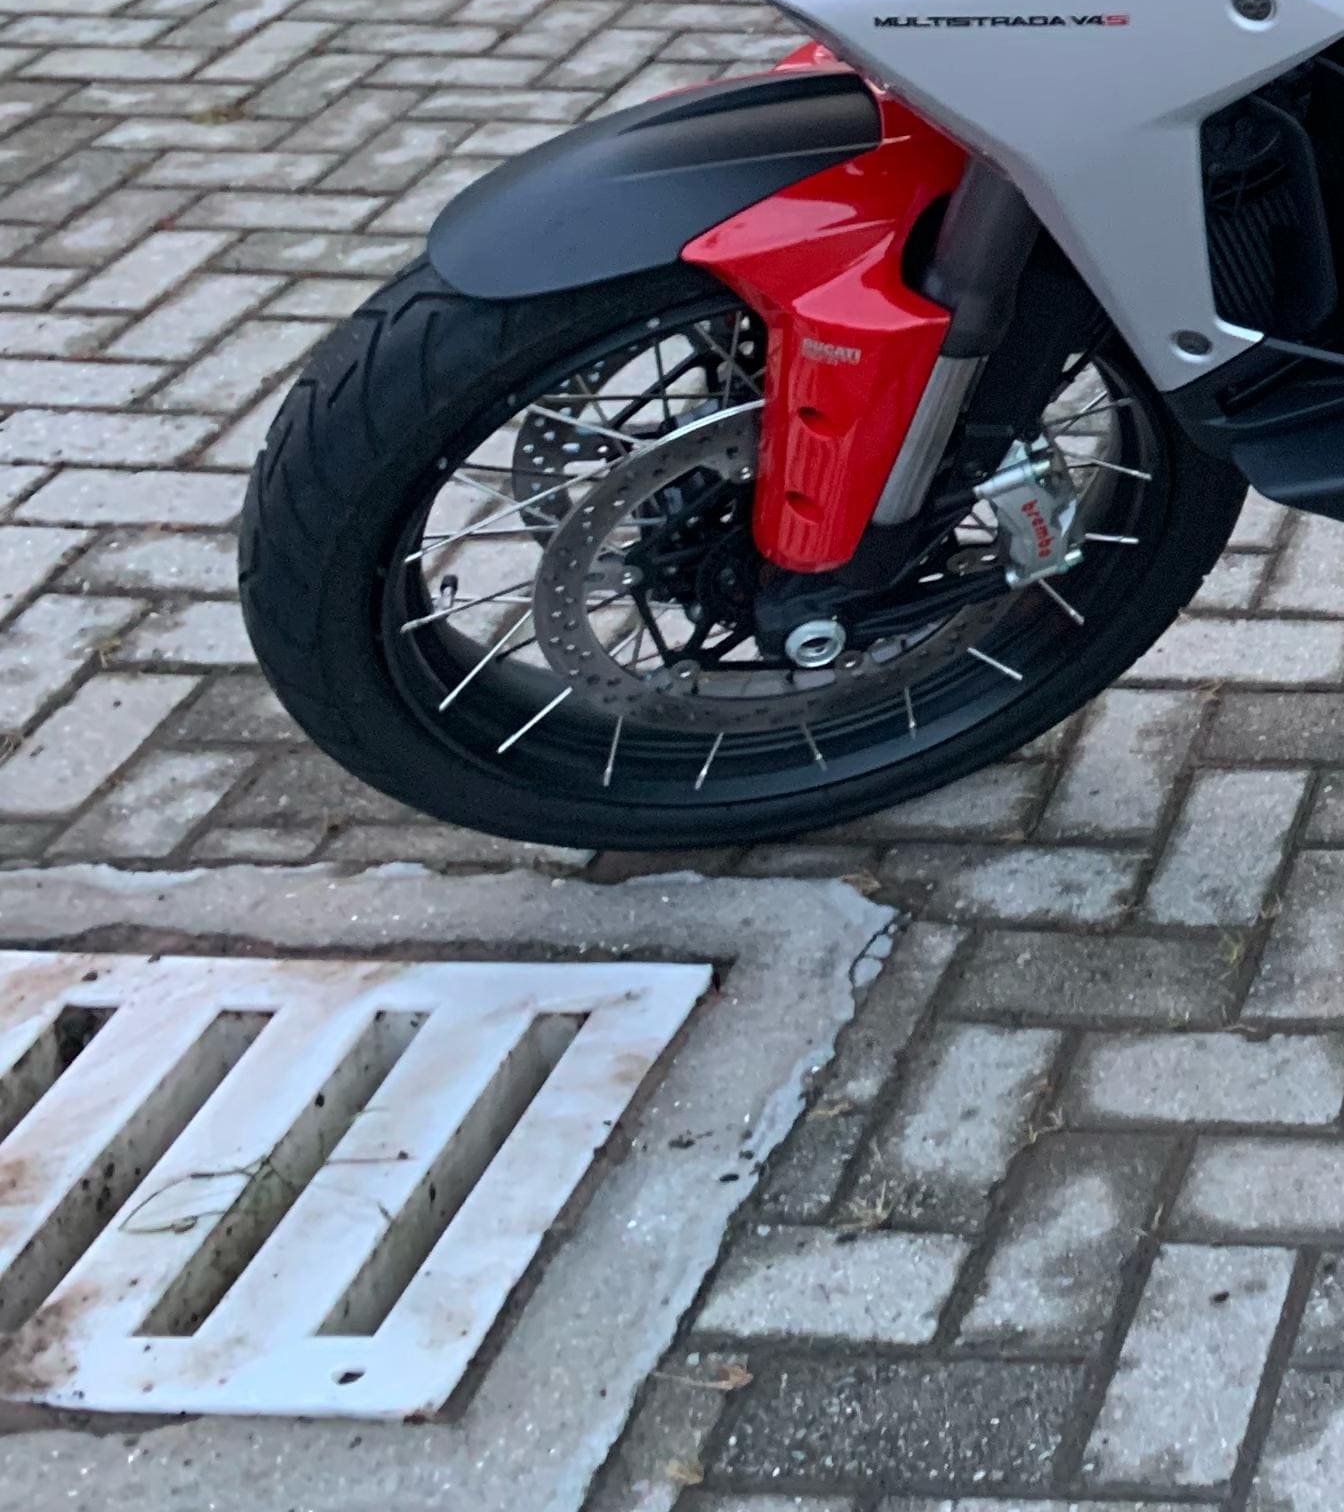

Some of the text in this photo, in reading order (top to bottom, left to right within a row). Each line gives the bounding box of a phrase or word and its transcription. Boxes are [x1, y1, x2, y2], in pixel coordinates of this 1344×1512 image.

[873, 13, 1130, 28] MULTISTRADA V4S
[803, 338, 862, 362] DUCATI
[1020, 498, 1053, 558] brembo
